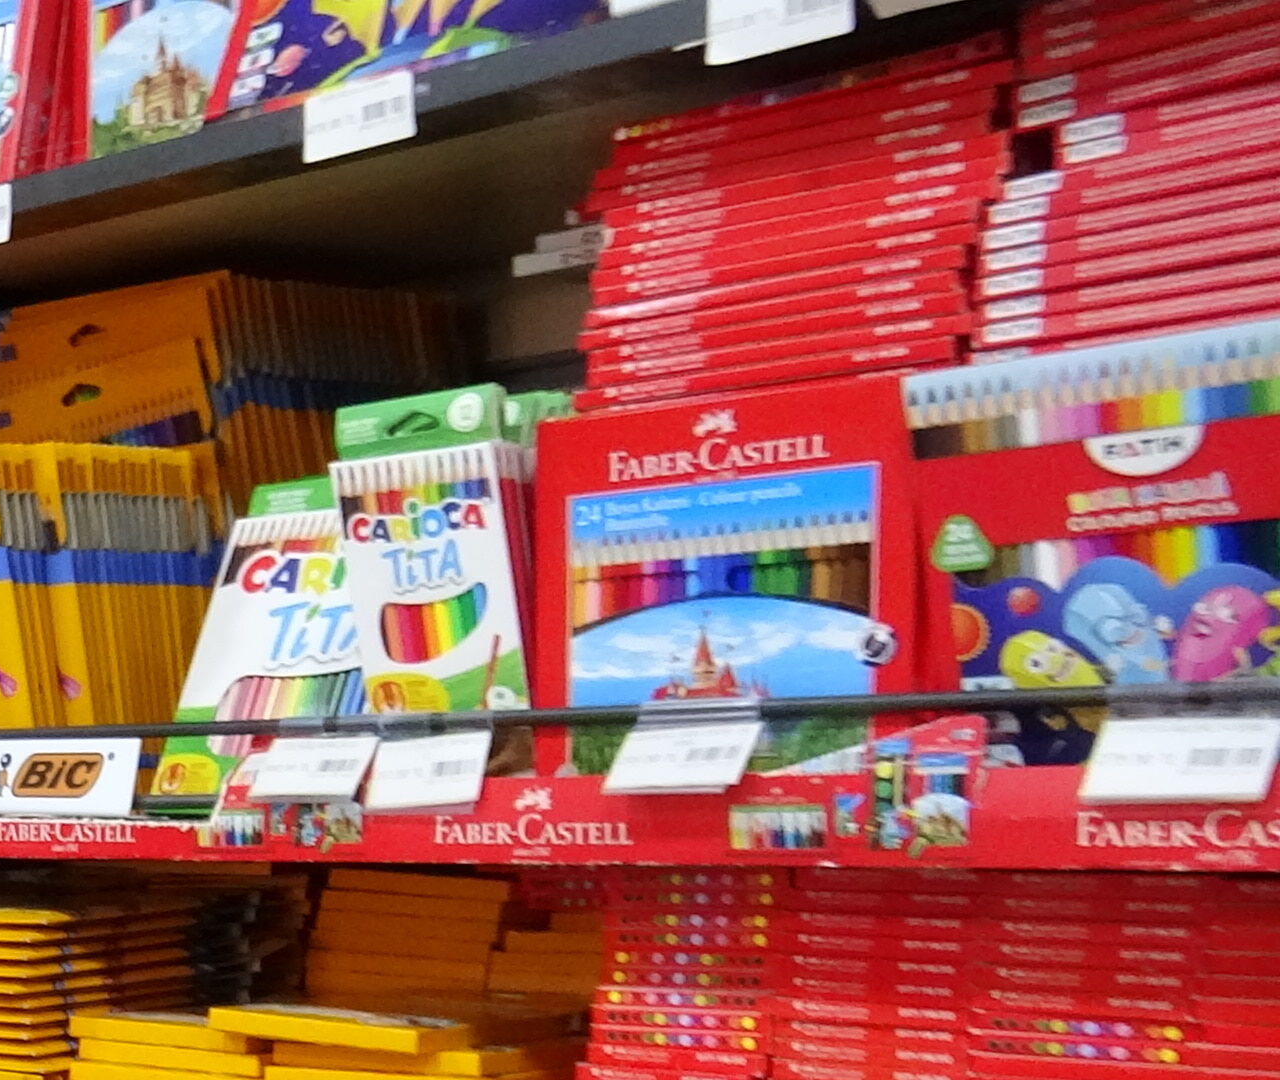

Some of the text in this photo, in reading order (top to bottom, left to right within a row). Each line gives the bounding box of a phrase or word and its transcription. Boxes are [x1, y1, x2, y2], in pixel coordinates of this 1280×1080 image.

[608, 434, 831, 484] FABER-CASTELL
[434, 814, 634, 847] FABER-CASTELL
[1076, 810, 1280, 847] FABER-CAS
